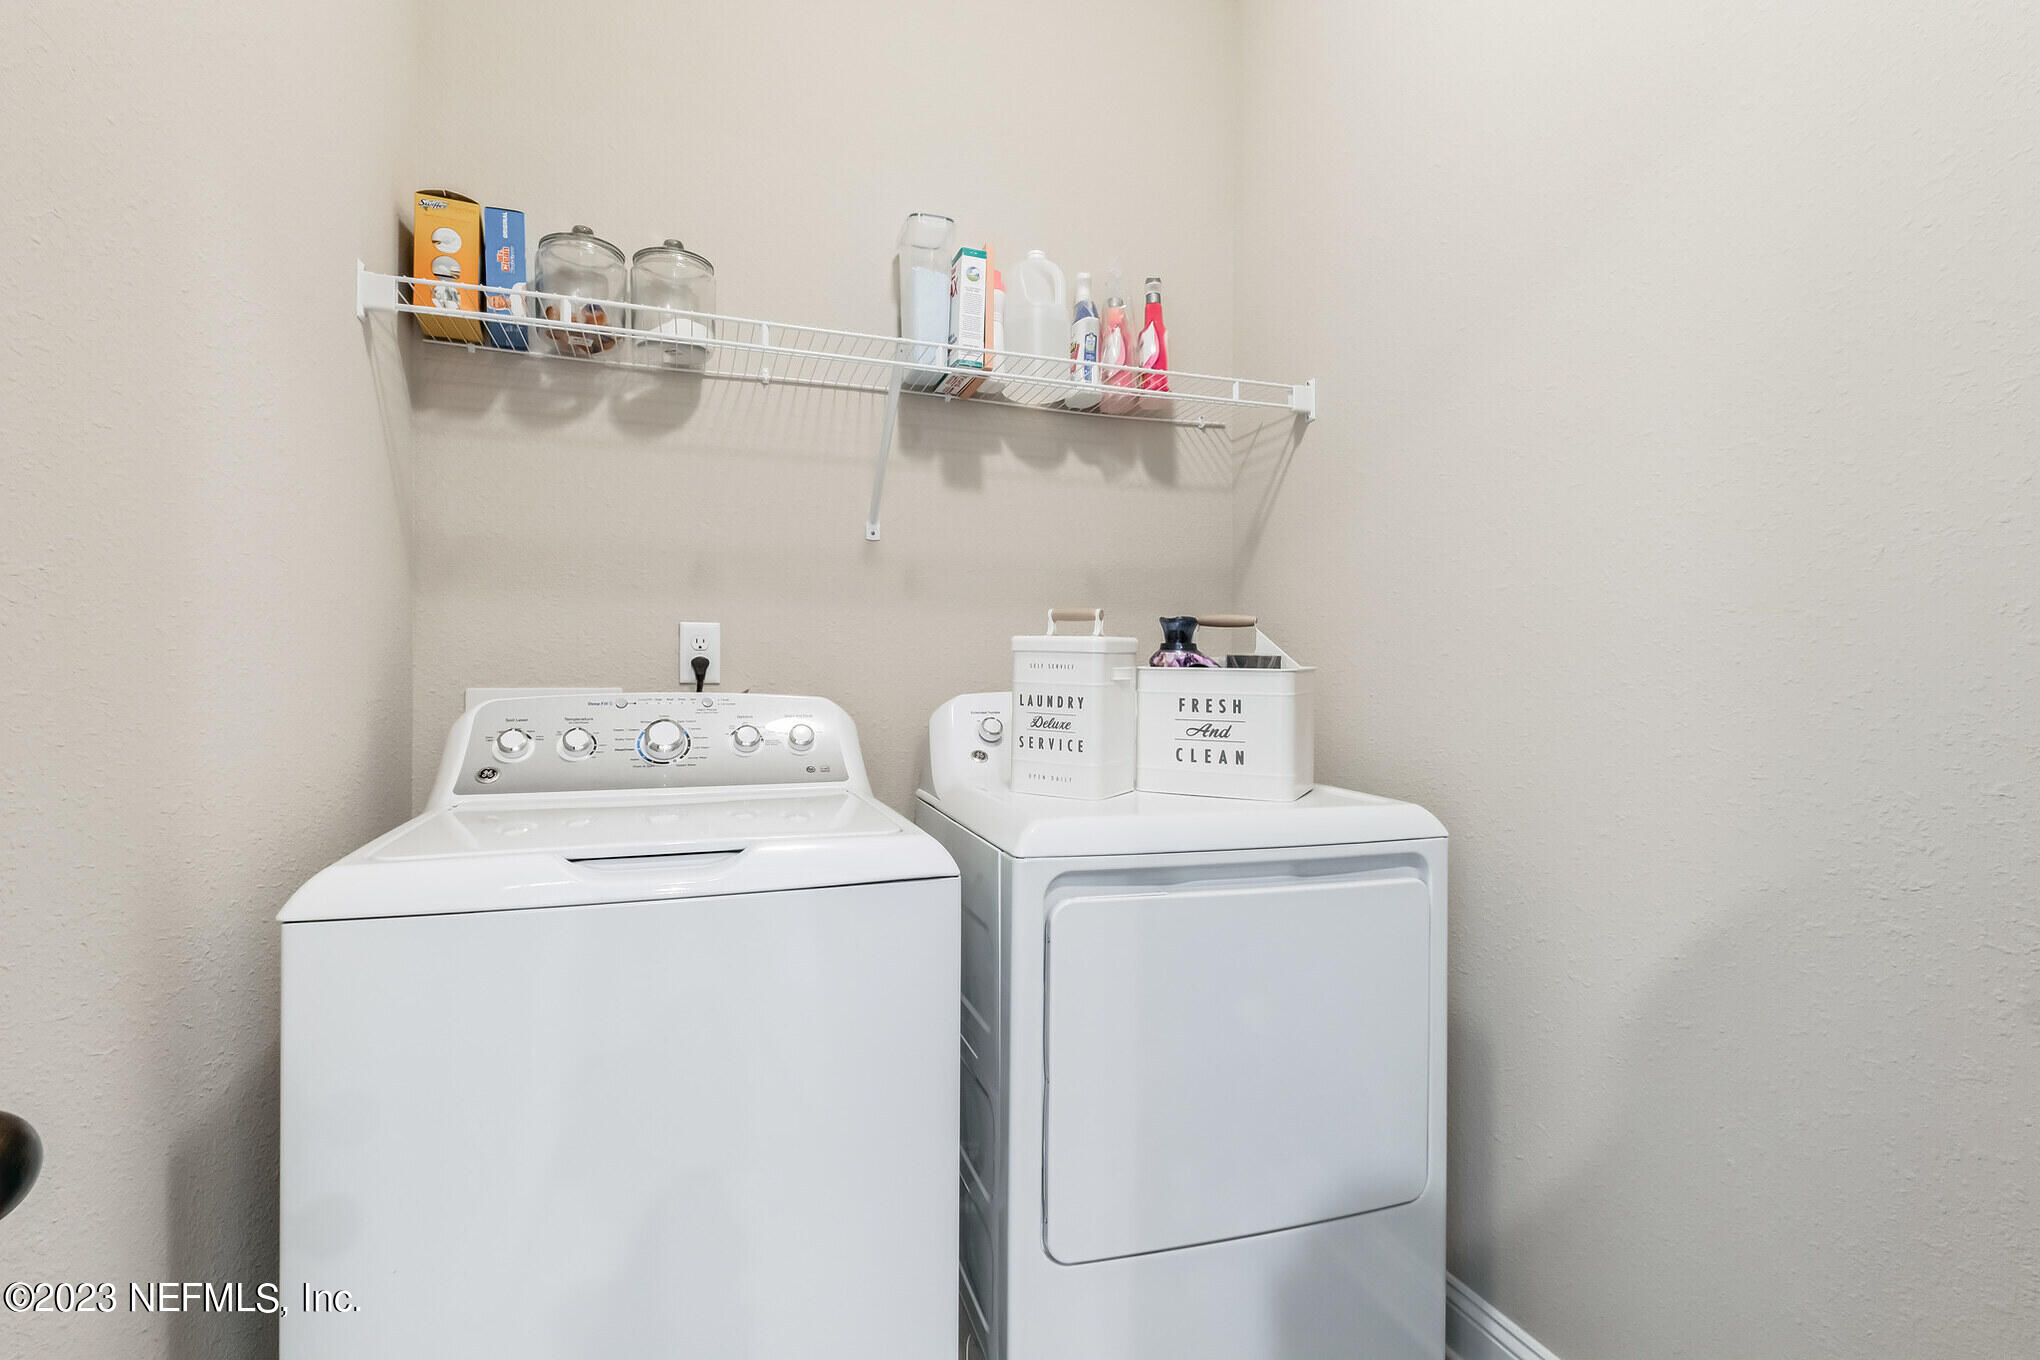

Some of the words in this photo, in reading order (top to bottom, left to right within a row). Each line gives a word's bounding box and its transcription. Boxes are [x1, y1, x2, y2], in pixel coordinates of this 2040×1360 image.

[1048, 663, 1075, 671] SERVICE
[1019, 693, 1084, 710] LAUNDRY
[1178, 697, 1242, 714] FRESH
[1030, 715, 1072, 730] Deluxe
[1185, 722, 1233, 738] And
[1019, 735, 1084, 753] SERVICE
[1175, 747, 1244, 766] CLEAN
